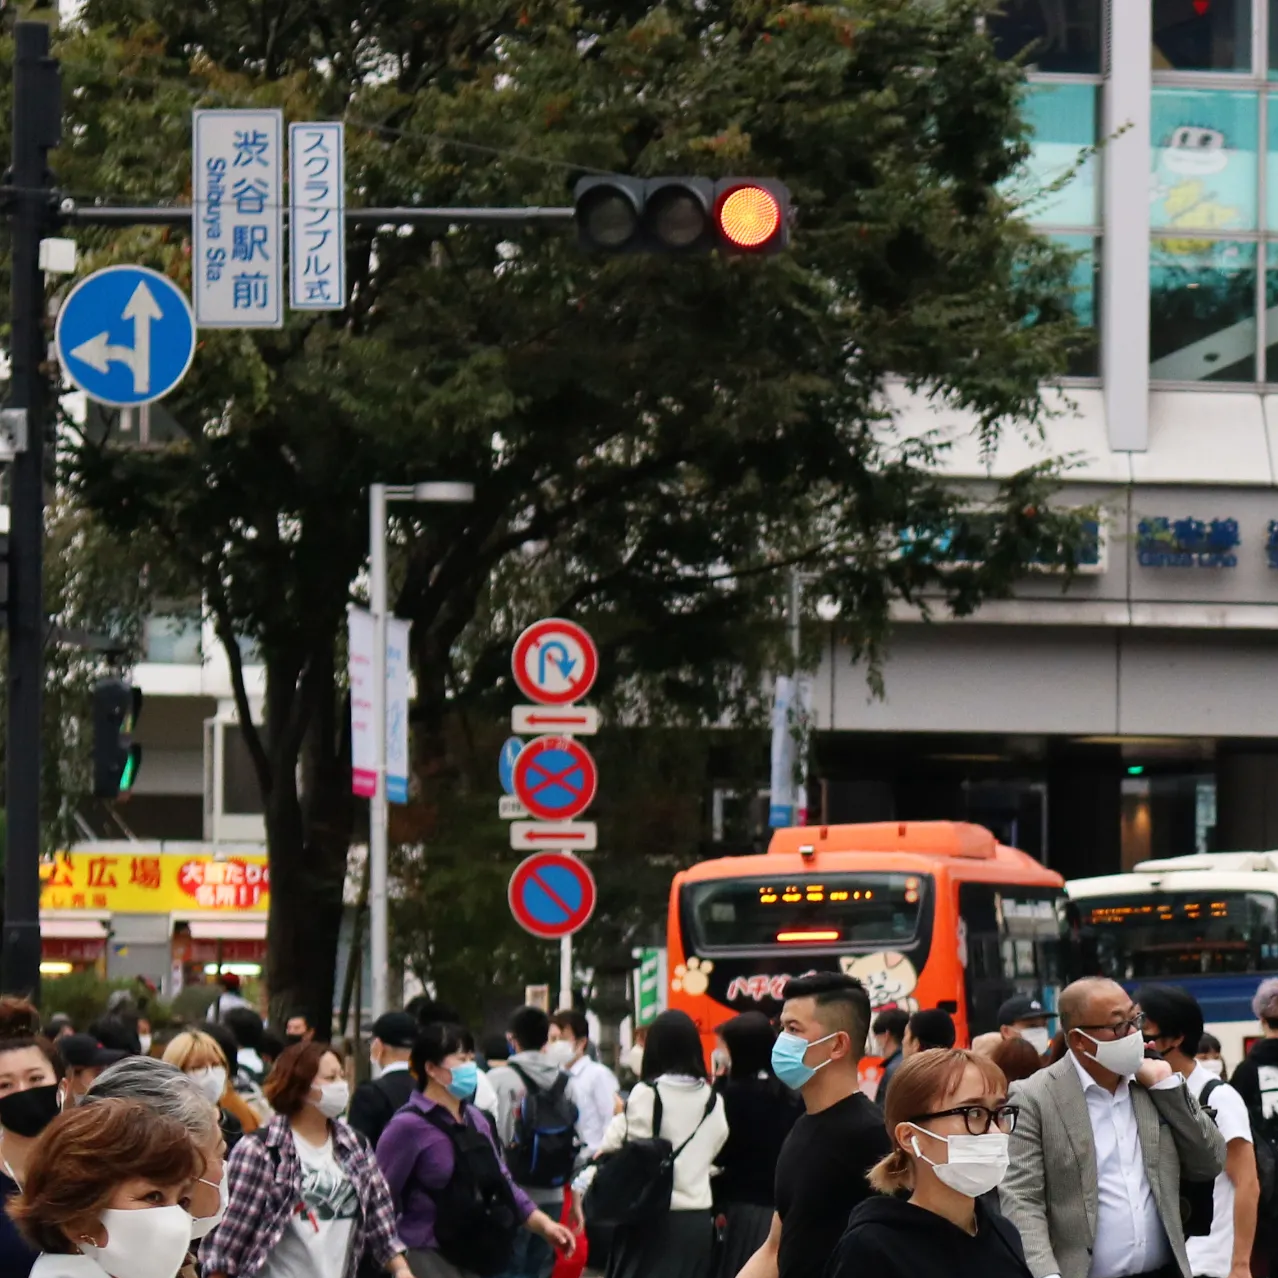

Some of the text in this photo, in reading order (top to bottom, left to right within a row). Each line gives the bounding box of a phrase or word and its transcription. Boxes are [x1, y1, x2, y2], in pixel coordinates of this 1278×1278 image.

[204, 157, 227, 289] Shibuya Sta.
[232, 130, 269, 309] 渋谷駅前
[304, 132, 331, 300] スクランブル式
